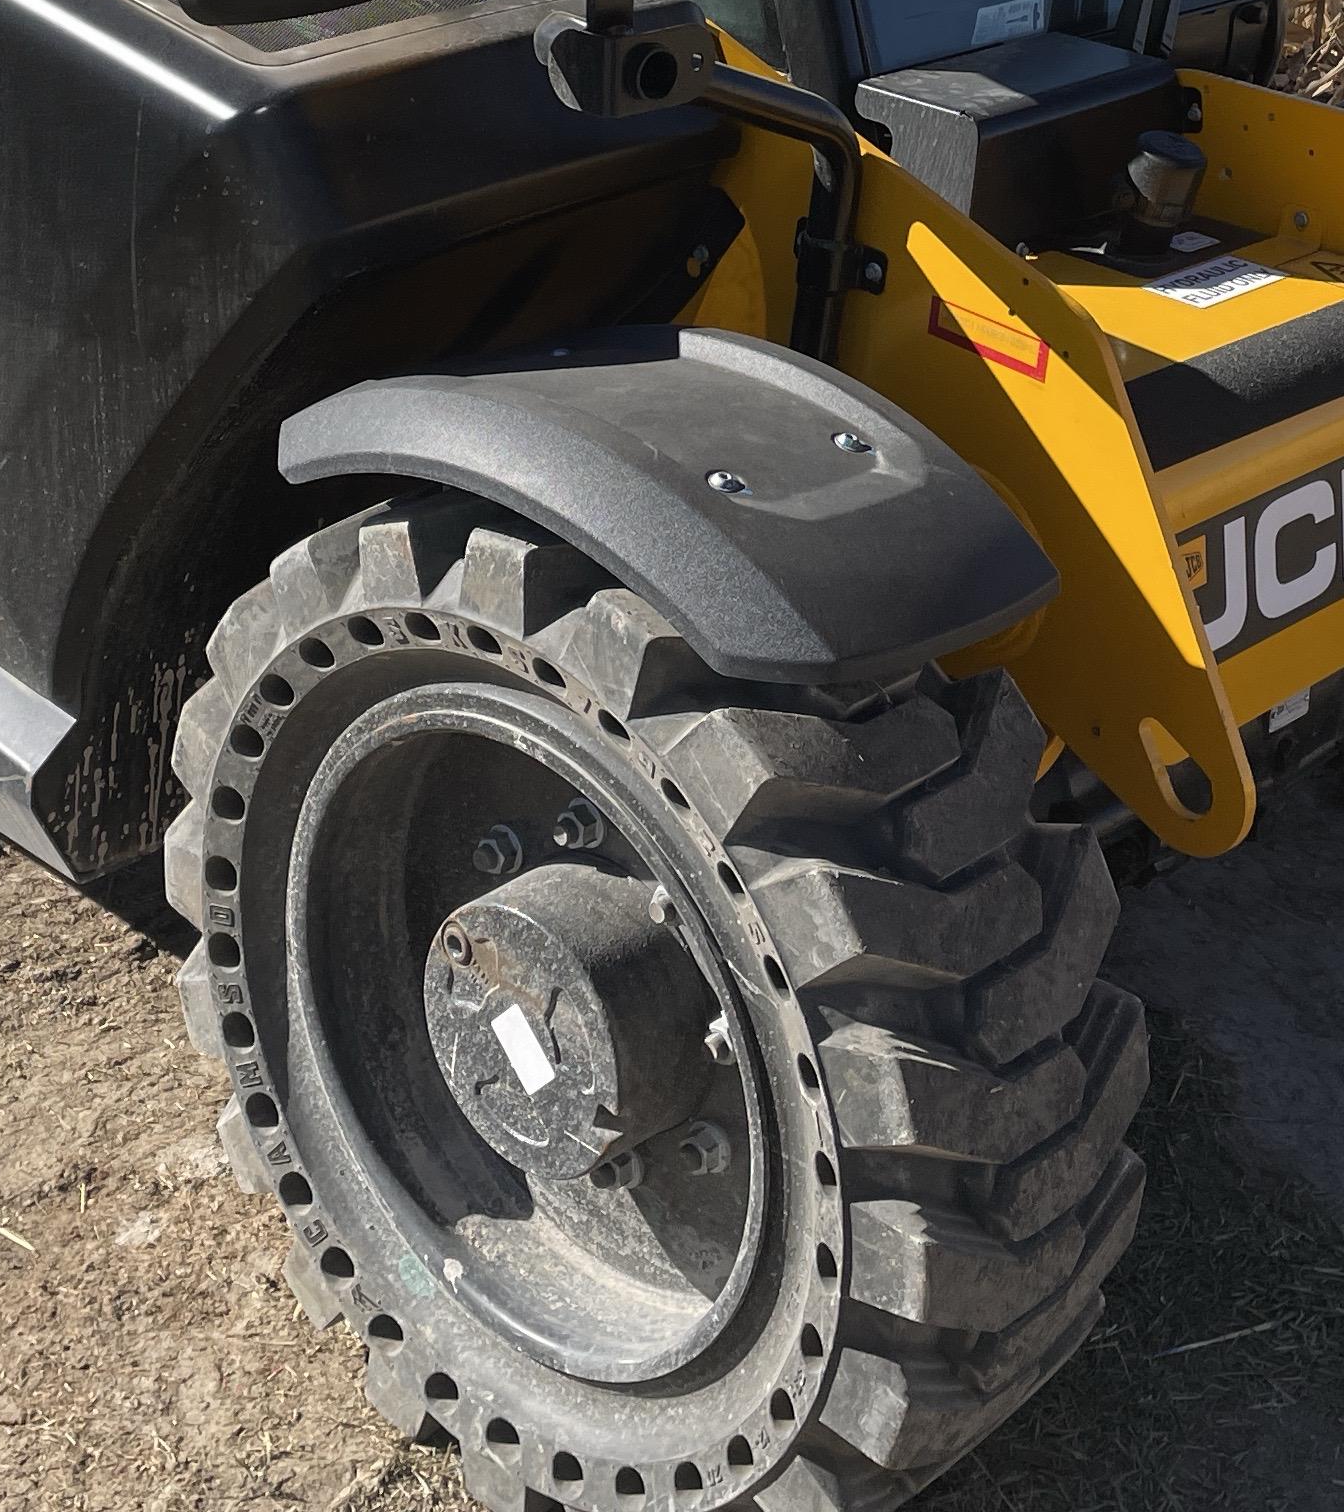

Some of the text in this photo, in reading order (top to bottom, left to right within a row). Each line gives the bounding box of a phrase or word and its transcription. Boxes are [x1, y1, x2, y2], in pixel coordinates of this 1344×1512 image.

[1155, 258, 1250, 295] HYDRAULIC
[1182, 267, 1272, 304] FLUID ONLY
